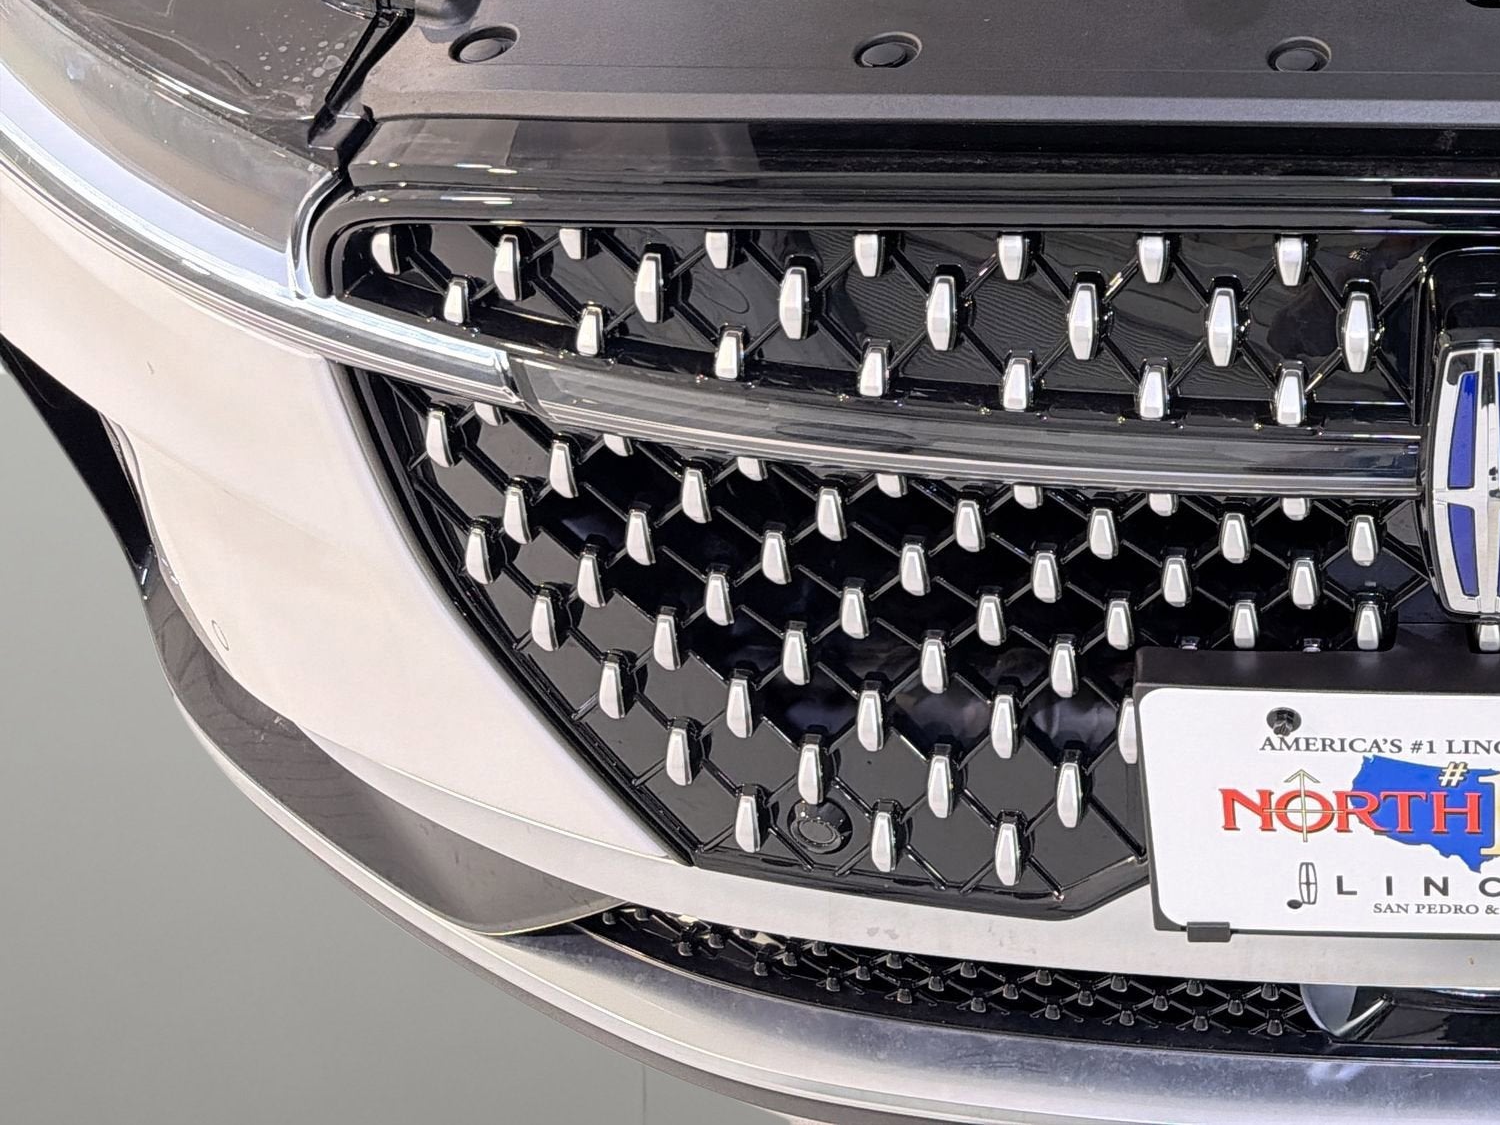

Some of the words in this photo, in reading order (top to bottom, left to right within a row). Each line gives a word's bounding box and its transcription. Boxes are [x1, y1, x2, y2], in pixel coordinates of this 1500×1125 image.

[1259, 736, 1402, 753] AMERICA'S
[1410, 739, 1435, 754] #1
[1221, 787, 1483, 836] NORTH
[1373, 903, 1410, 914] SAN
[1415, 903, 1478, 915] PEDRO
[1484, 904, 1499, 915] &
